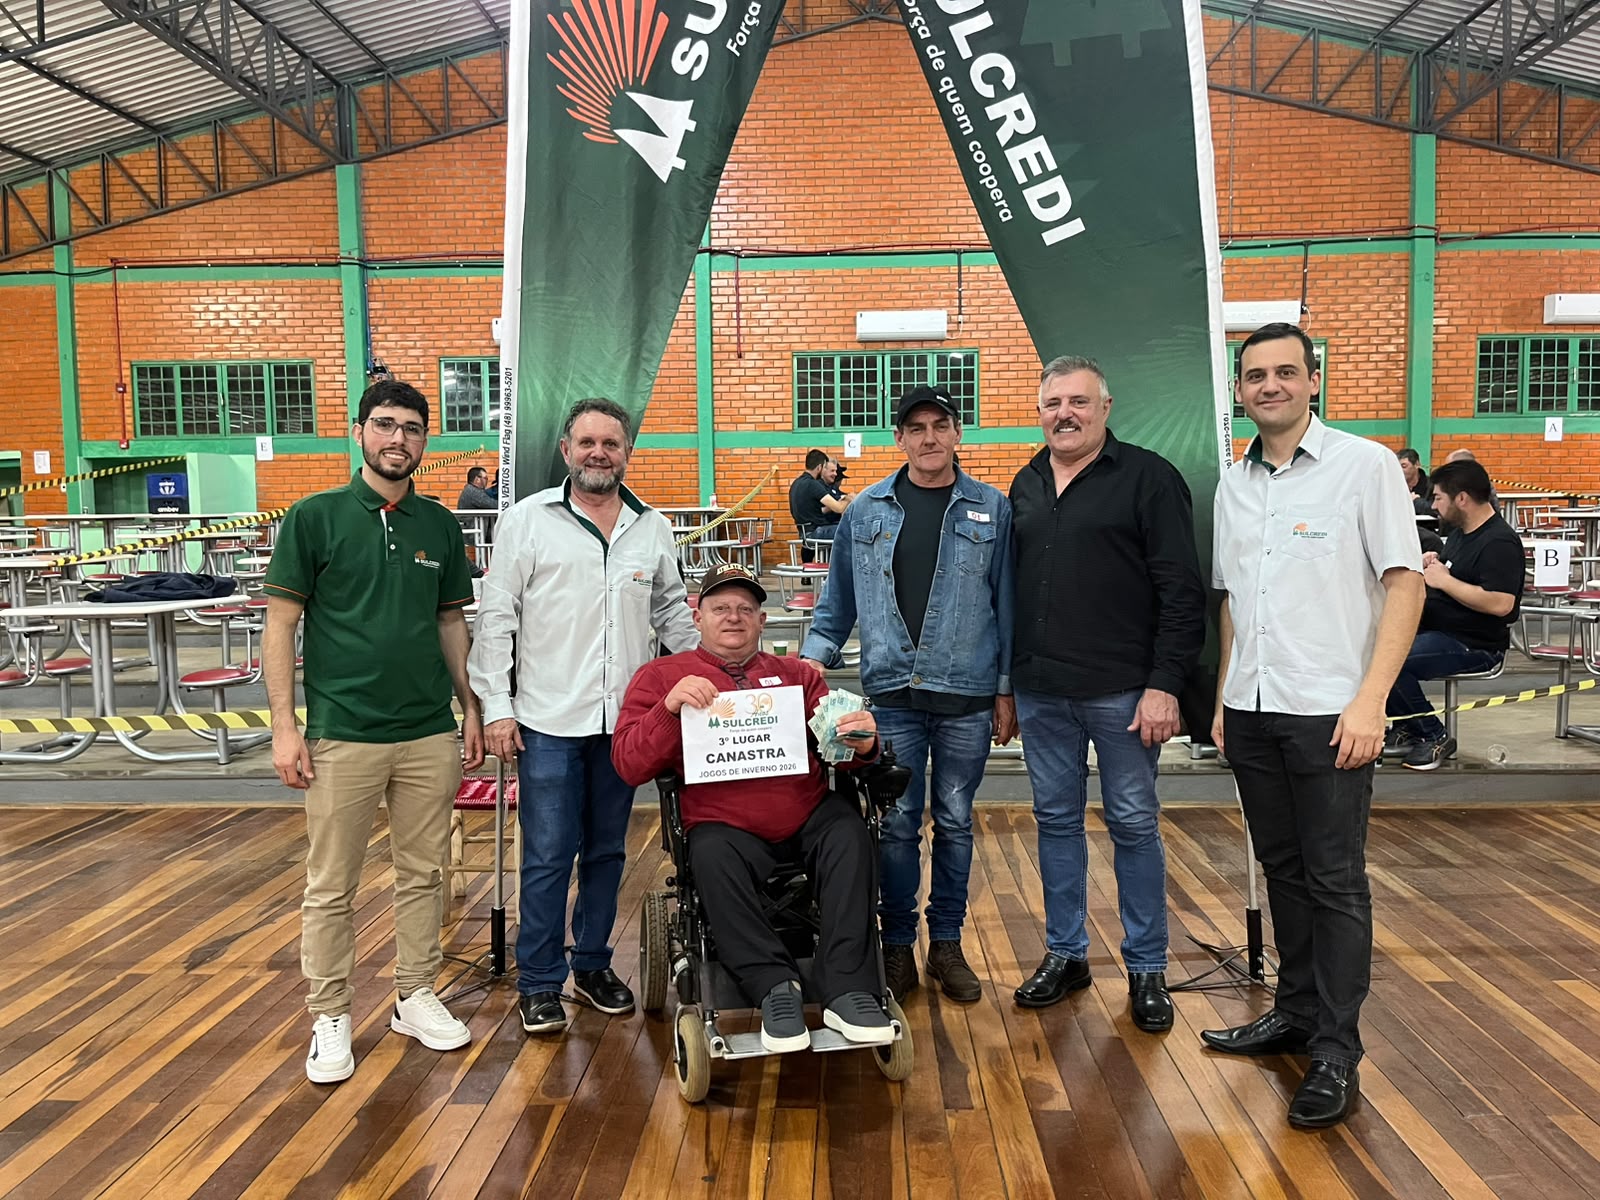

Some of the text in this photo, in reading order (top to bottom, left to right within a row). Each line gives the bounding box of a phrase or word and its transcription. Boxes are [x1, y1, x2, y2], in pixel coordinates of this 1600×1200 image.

[725, 1, 762, 57] Força
[935, 0, 1086, 246] LCREDI
[925, 45, 946, 71] de
[939, 76, 974, 136] quem
[967, 140, 1014, 223] coopera
[504, 367, 513, 411] 99963-5201
[503, 413, 513, 427] (48)
[1548, 423, 1558, 432] A
[502, 428, 513, 446] Flag
[848, 438, 856, 449] C
[261, 442, 268, 452] E
[501, 446, 511, 465] Wind
[501, 468, 511, 498] VENTOS
[1544, 549, 1559, 567] B
[722, 716, 778, 728] SULCREDI
[732, 733, 771, 745] LUGAR
[706, 748, 786, 764] CANASTRA
[699, 762, 797, 778] JOGOS DE INVERNO 2026
